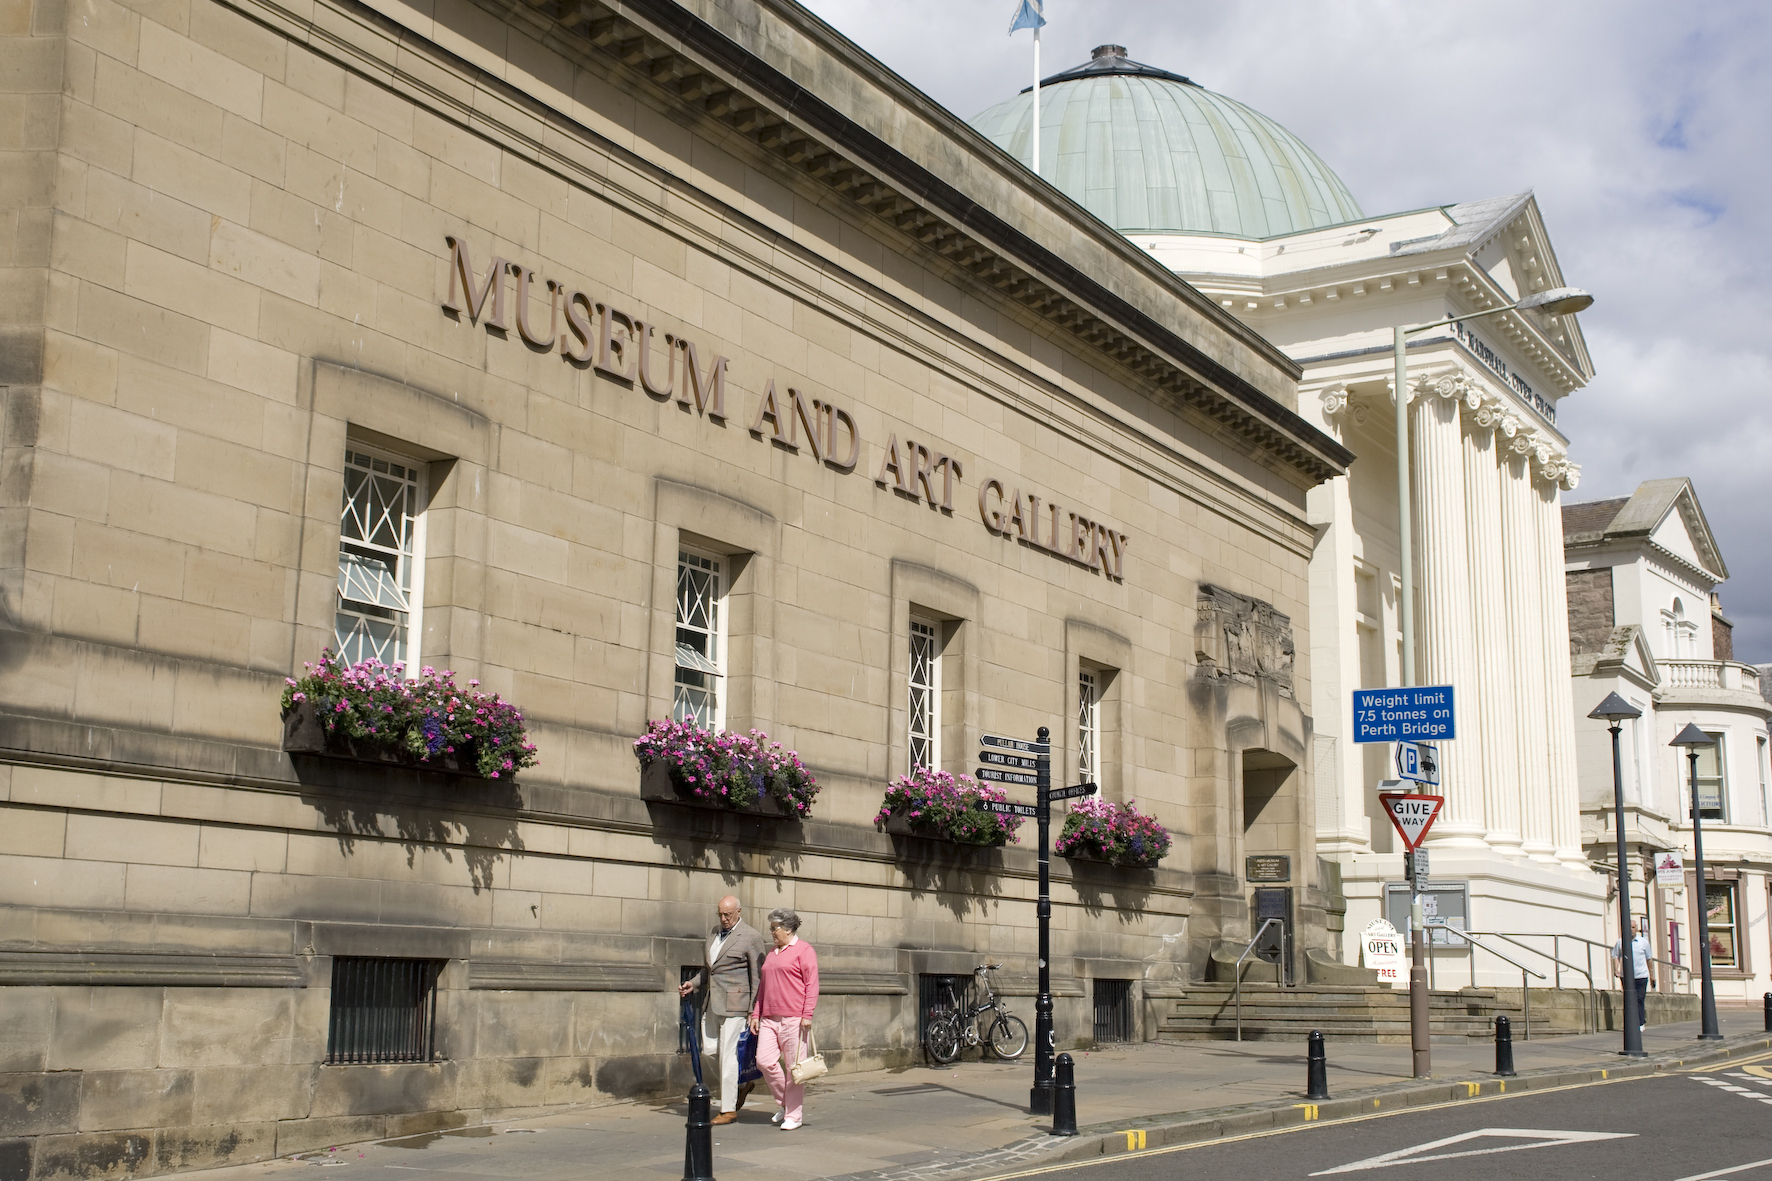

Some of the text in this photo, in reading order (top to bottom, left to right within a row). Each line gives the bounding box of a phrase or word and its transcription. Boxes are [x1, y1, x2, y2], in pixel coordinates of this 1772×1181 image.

[441, 236, 1130, 582] MUSEUM AND ART GALLERY
[1361, 692, 1445, 709] Weight limit
[1358, 708, 1450, 722] 7.5 tonnes on
[1361, 722, 1447, 736] Perth Bridge
[988, 753, 1036, 768] LOWER CITY MILLS
[1408, 751, 1416, 772] P
[982, 770, 1037, 784] TOURIST INFORMATION
[992, 803, 1036, 815] PUBLIC TOILETS
[1394, 802, 1430, 816] GIVE
[1402, 817, 1425, 827] WAY
[1366, 919, 1394, 931] MUSEUM
[1368, 941, 1398, 954] OPEN
[1377, 969, 1397, 978] FREE
